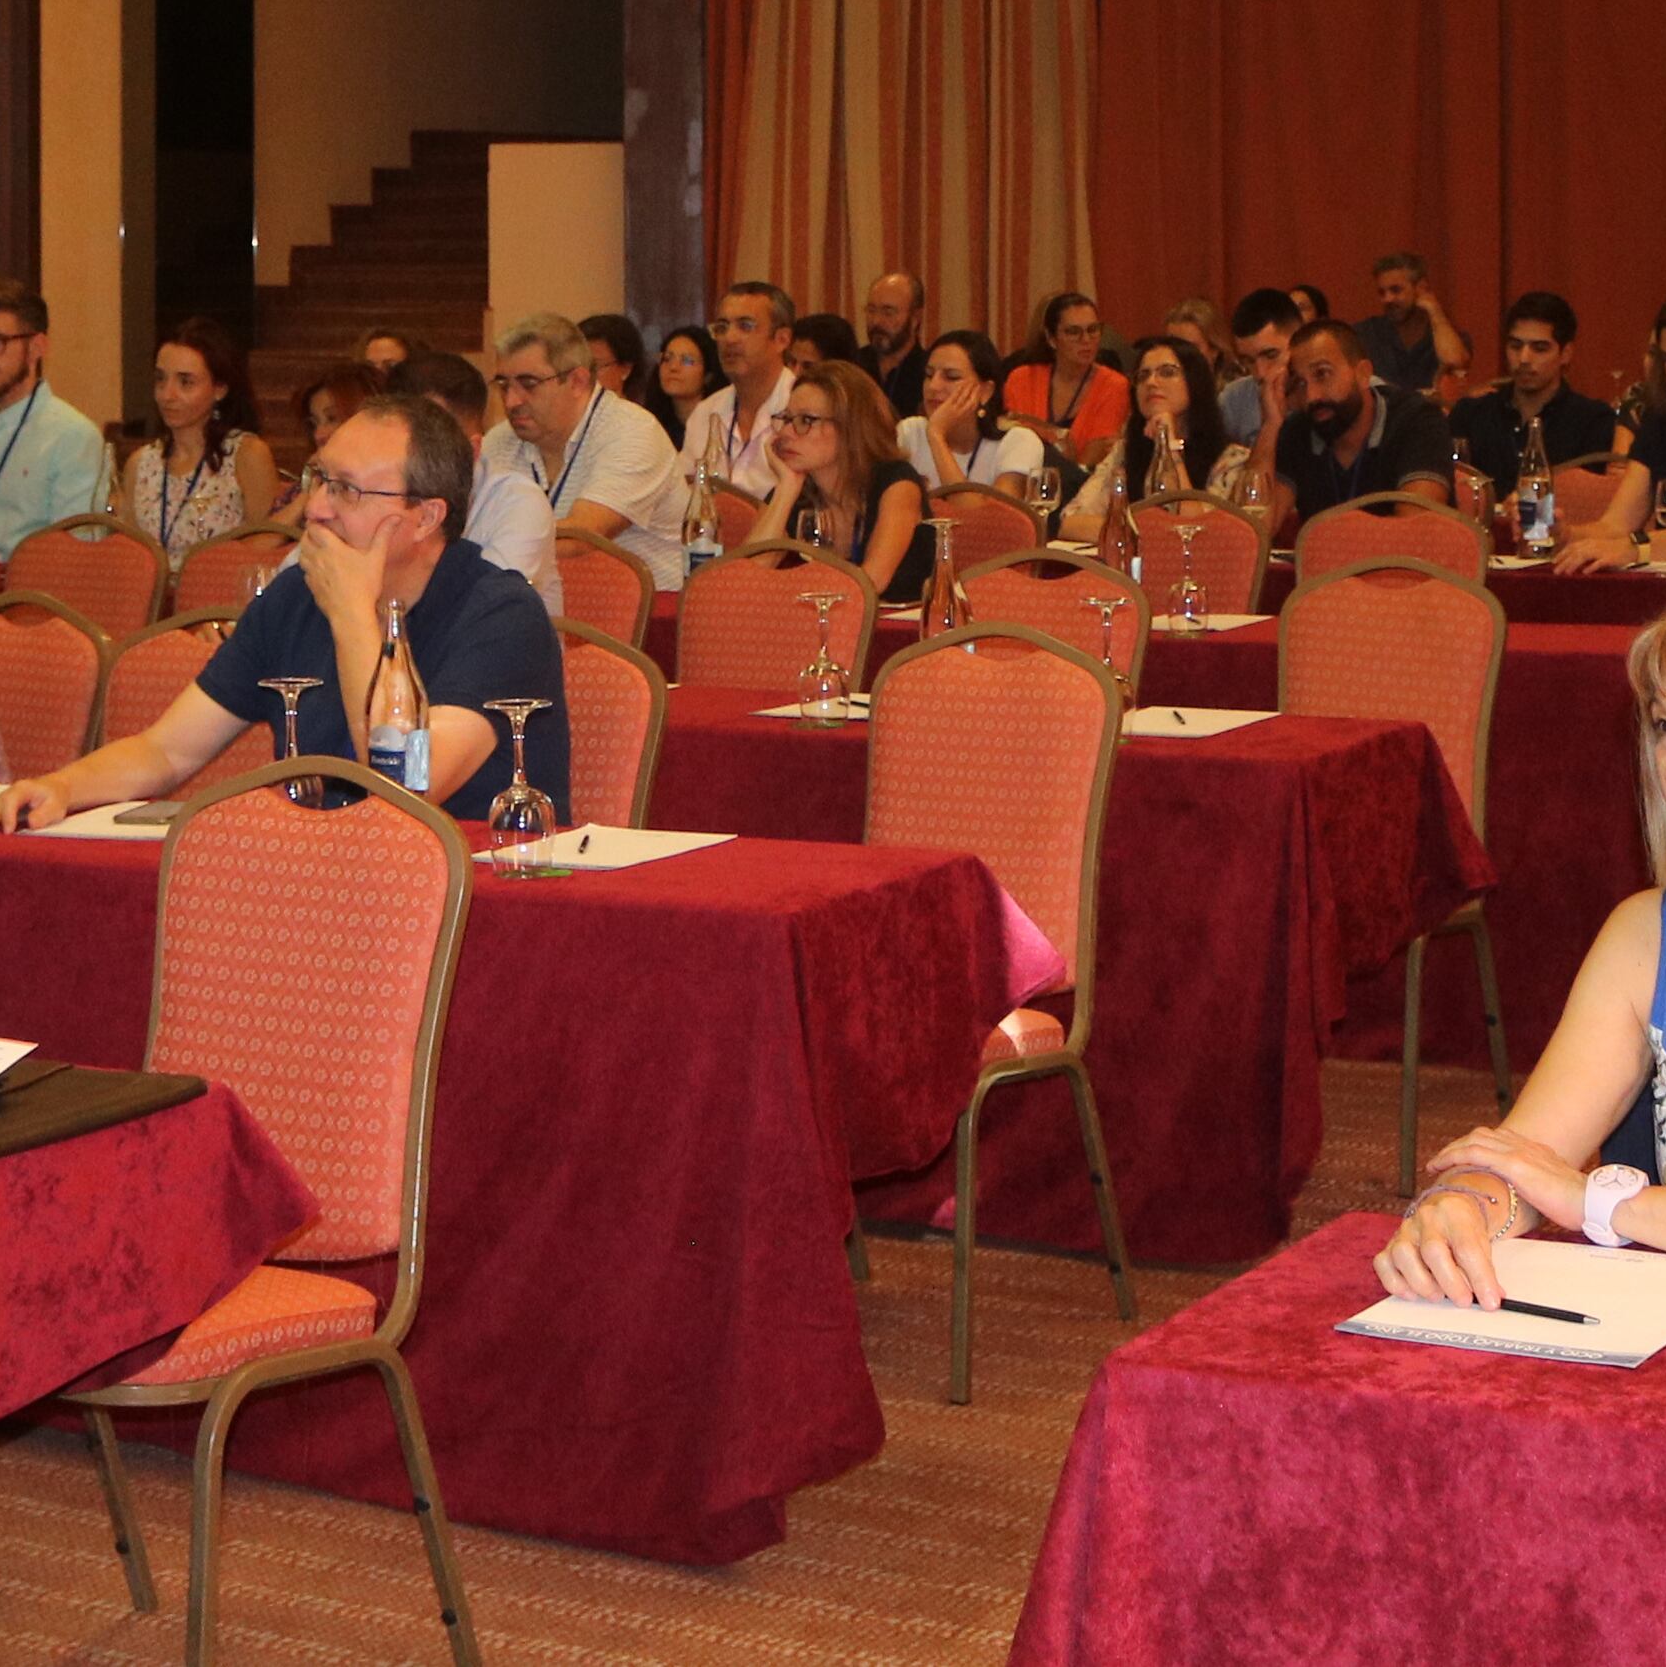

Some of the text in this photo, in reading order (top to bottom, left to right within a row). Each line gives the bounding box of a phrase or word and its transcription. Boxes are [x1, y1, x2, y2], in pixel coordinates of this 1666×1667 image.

[1425, 1333, 1470, 1345] TODO
[1473, 1339, 1543, 1353] TRABAJO
[1560, 1349, 1604, 1360] OCIO
